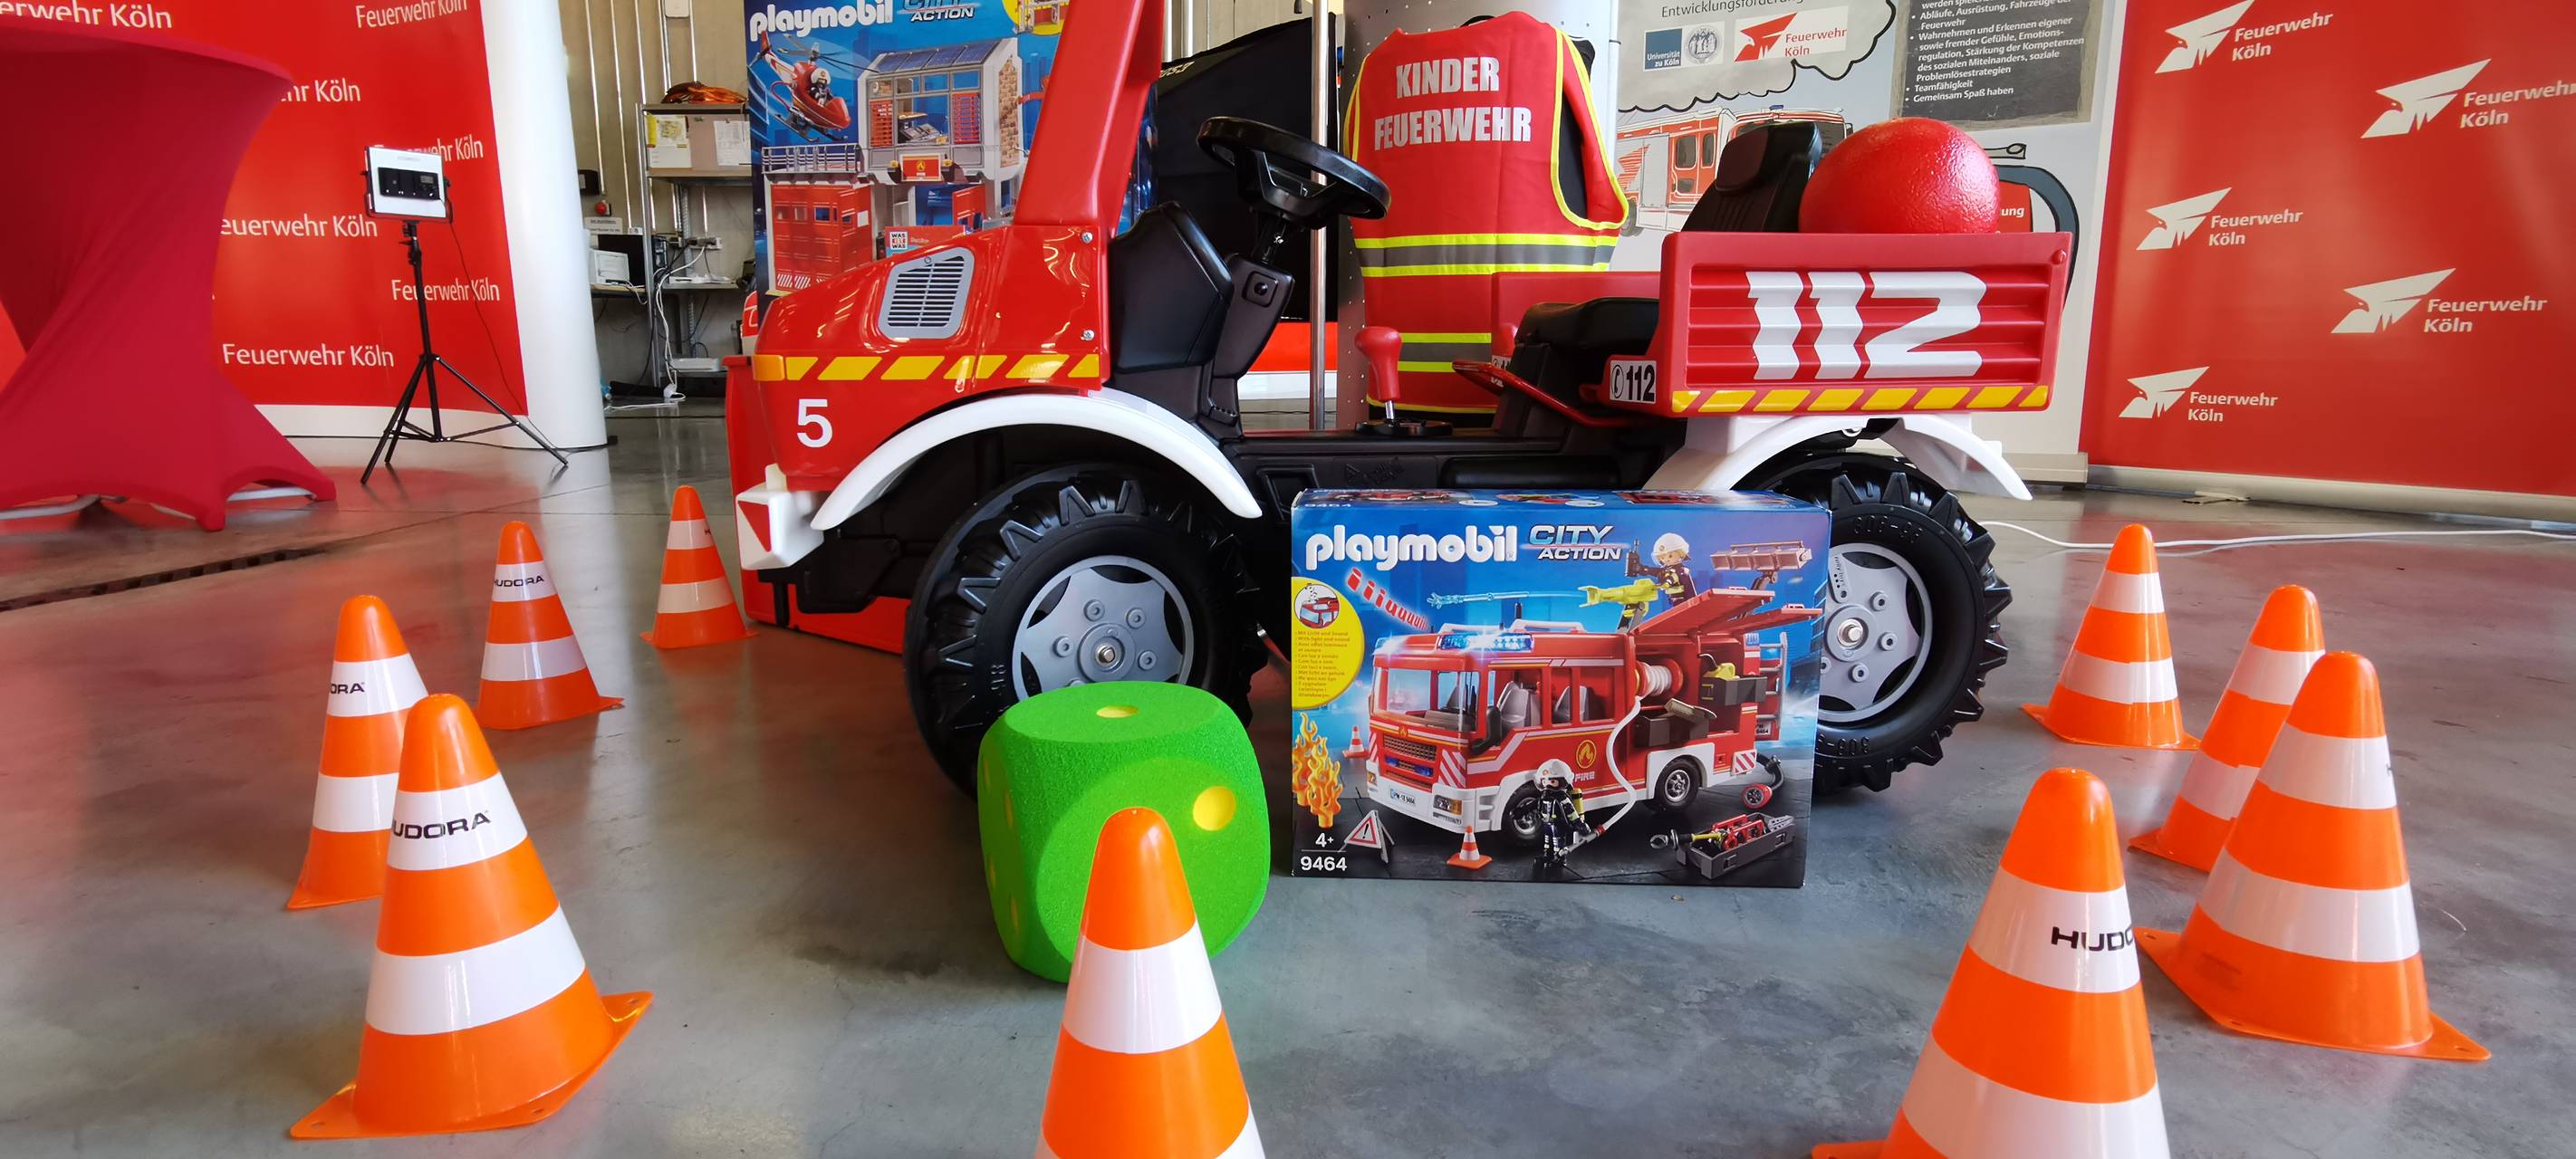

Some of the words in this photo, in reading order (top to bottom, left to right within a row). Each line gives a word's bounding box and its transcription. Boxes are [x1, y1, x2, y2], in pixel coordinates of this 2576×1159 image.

[0, 0, 102, 24] erwehr
[110, 4, 172, 28] Köln
[355, 0, 437, 28] Feuerwehr
[910, 7, 975, 22] ACTION
[1921, 0, 1954, 9] werden
[750, 0, 893, 41] playmobil
[1918, 29, 1975, 41] Wahrnehmen
[1977, 24, 1994, 34] und
[1995, 22, 2037, 33] Erkennen
[2038, 17, 2073, 28] eigener
[1920, 18, 1966, 31] Feuerwehr
[2235, 13, 2333, 42] Feuerwehr
[1785, 28, 1848, 43] Feuerwehr
[1918, 42, 1945, 52] sowie
[1945, 38, 1980, 49] fremder
[2018, 29, 2064, 41] Emotions-
[1647, 51, 1681, 61] Universität
[1784, 46, 1810, 57] Köln
[1966, 46, 2005, 57] Stärkung
[2005, 43, 2022, 53] der
[2022, 37, 2085, 51] Kompetenzen
[2232, 42, 2272, 62] Köln
[1664, 59, 1679, 67] Köln
[1918, 62, 1932, 72] des
[1933, 60, 1967, 70] sozialen
[2029, 49, 2061, 61] soziale
[1396, 56, 1500, 100] KINDER
[1916, 66, 2012, 82] Problemlösestrategien
[314, 78, 361, 102] Köln
[1913, 91, 1963, 102] Gemeinsam
[1964, 88, 1986, 100] Spaß
[1986, 87, 2014, 96] haben
[1914, 80, 1974, 92] Teamfähigkeit
[1374, 107, 1532, 151] FEUERWEHR
[2460, 110, 2509, 129] Köln
[456, 134, 484, 160] Köln
[2000, 207, 2024, 217] ung
[2210, 209, 2303, 229] Feuerwehr
[221, 214, 328, 237] euerwehr
[332, 215, 378, 237] Köln
[2208, 230, 2246, 246] Köln
[471, 278, 501, 301] Köln
[2427, 295, 2547, 313] Feuerwehr
[1746, 272, 1987, 380] 112
[2423, 316, 2473, 333] Köln
[223, 343, 345, 366] Feuerwehr
[350, 345, 394, 367] Köln
[1627, 364, 1656, 402] 112
[2189, 391, 2279, 407] Feuerwehr
[796, 398, 834, 448] 5
[2187, 407, 2224, 423] Köln
[1528, 524, 1616, 545] CITY
[1305, 523, 1519, 571] playmobil
[1537, 547, 1622, 561] ACTION
[330, 683, 365, 694] ORA
[392, 812, 492, 839] UDORA
[1315, 832, 1334, 848] 4+
[1300, 856, 1348, 871] 9464
